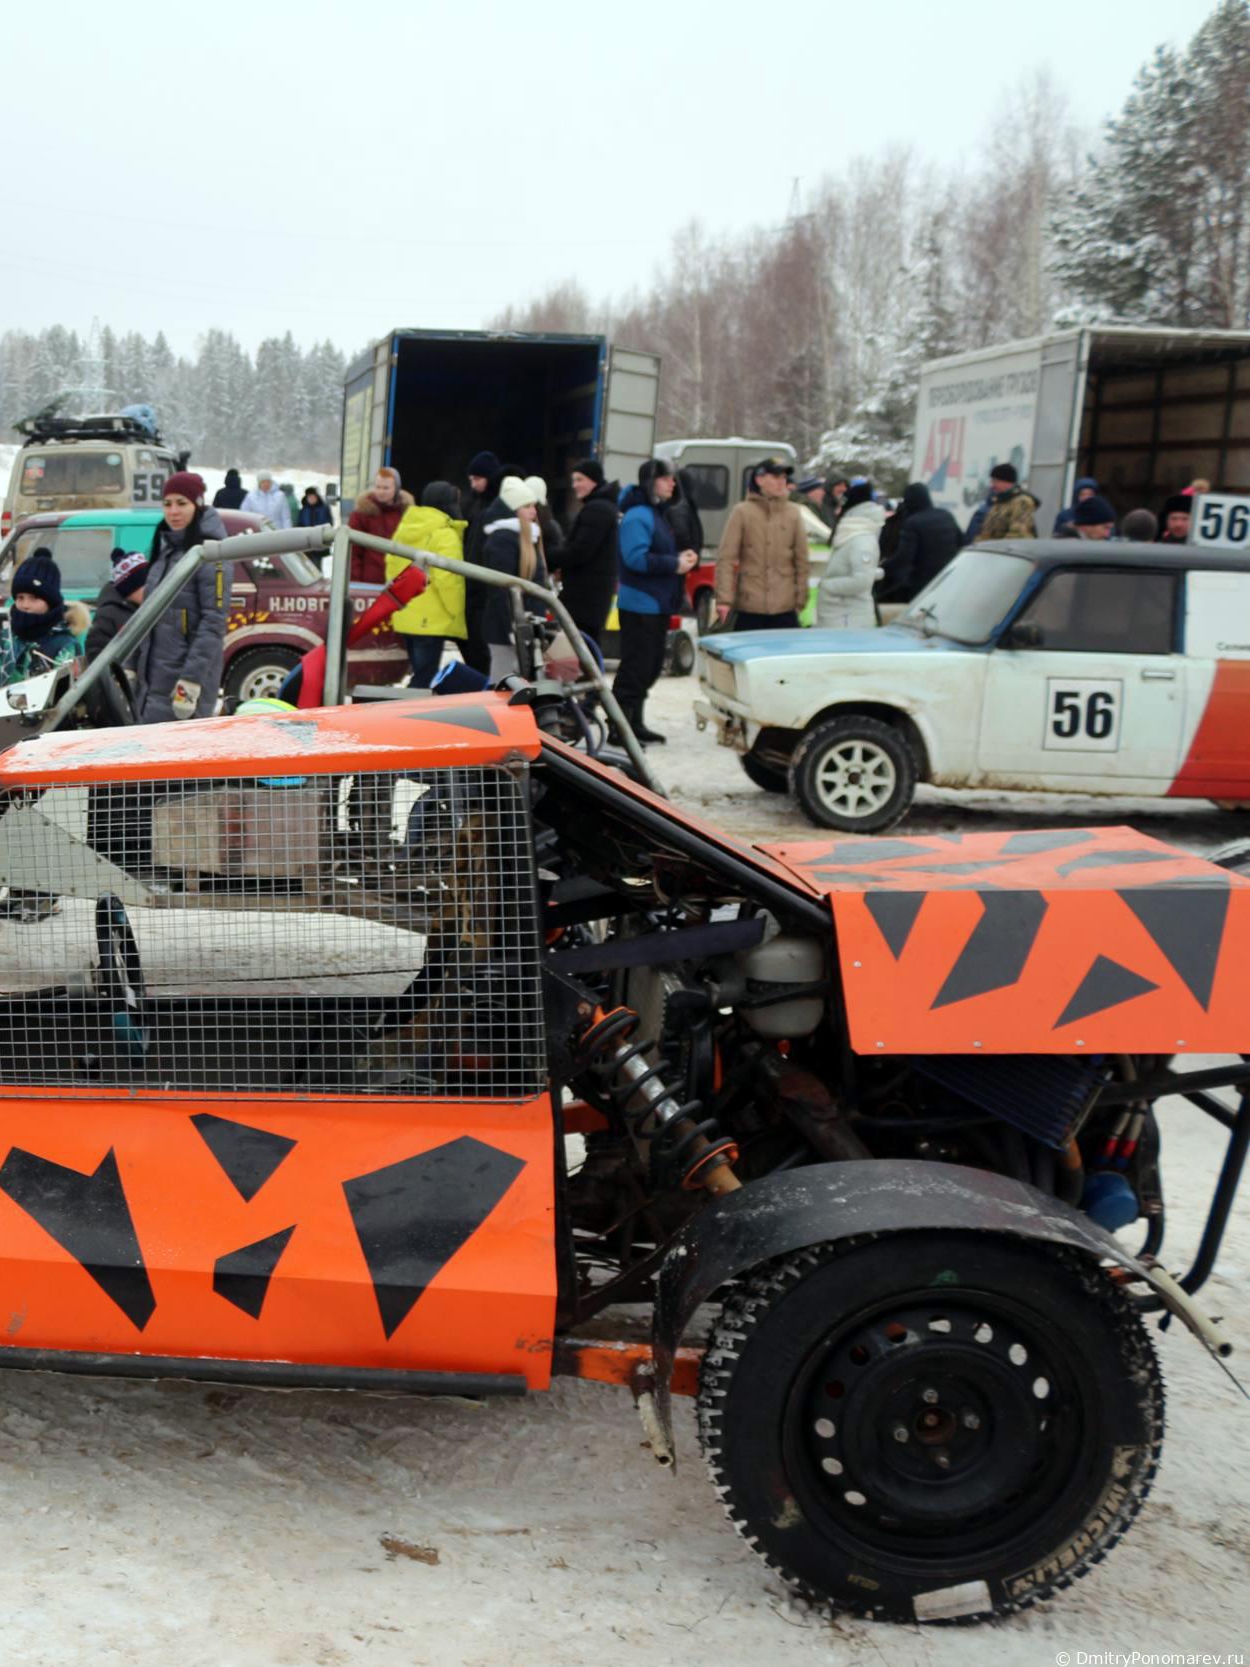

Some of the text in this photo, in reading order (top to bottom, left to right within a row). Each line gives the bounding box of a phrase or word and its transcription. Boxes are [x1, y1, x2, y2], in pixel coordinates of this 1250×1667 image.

[133, 474, 164, 501] 59
[1201, 503, 1249, 542] 56
[1053, 691, 1114, 739] 56
